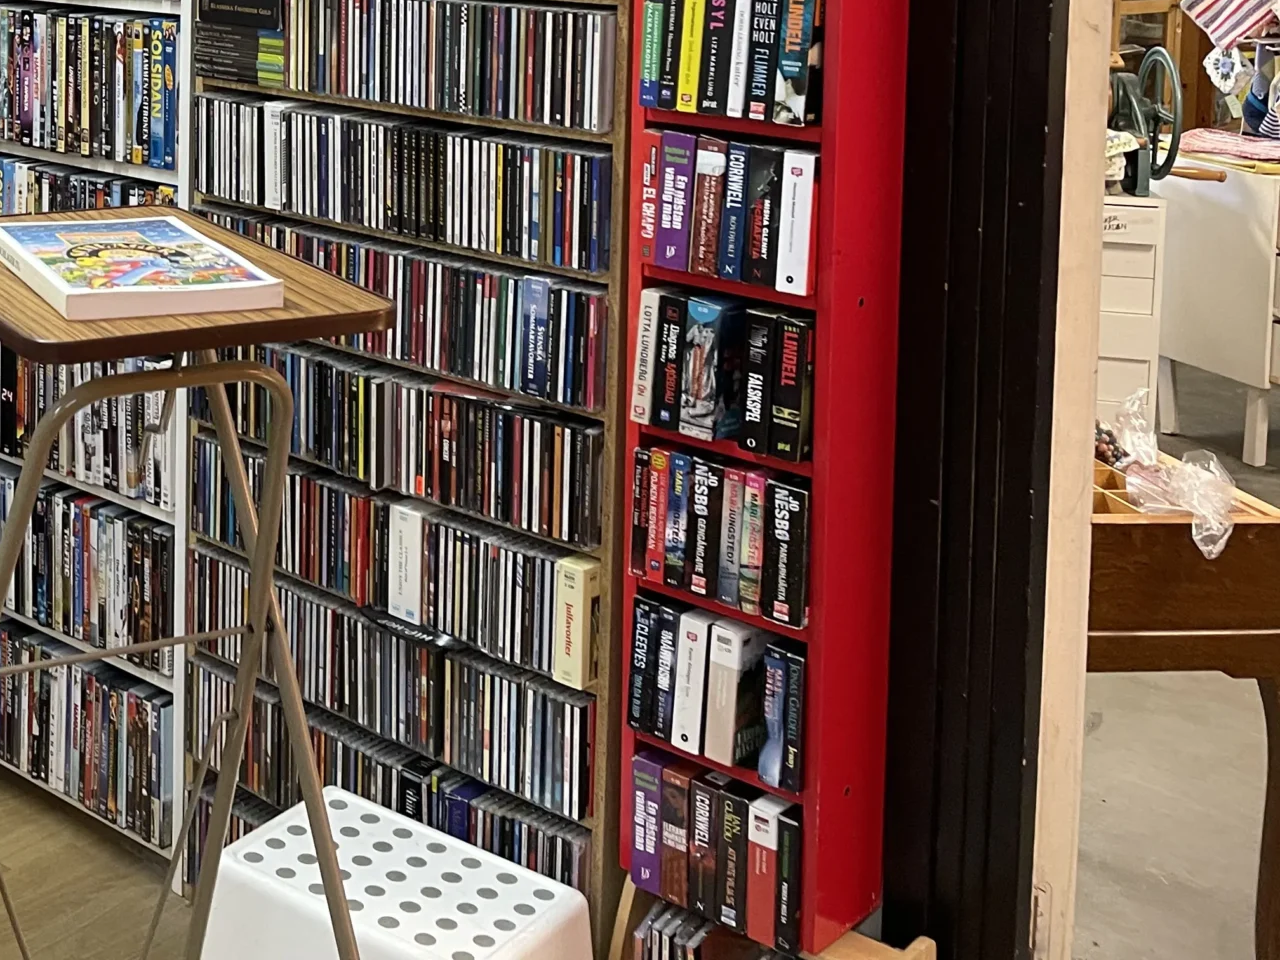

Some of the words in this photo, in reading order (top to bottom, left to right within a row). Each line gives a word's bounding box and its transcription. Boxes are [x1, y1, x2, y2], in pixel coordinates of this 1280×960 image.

[754, 2, 777, 15] HOLT
[754, 17, 776, 31] EVEN
[710, 37, 718, 54] LIZA
[753, 31, 775, 44] HOLT
[151, 30, 162, 119] SOLSIDAN
[706, 56, 717, 96] MARKLUND
[752, 48, 769, 96] FLIMMER
[644, 188, 656, 199] EL
[661, 167, 676, 204] vanlig
[675, 175, 688, 189] En
[726, 155, 747, 208] CORNWELL
[640, 202, 656, 238] CHAPO
[661, 206, 674, 229] man
[673, 190, 686, 229] nästan
[763, 200, 772, 226] MISHA
[761, 228, 770, 259] GLENNY
[642, 305, 654, 333] LOTTA
[638, 335, 651, 380] LUNDBERG
[780, 332, 800, 386] LINDELL
[1, 388, 14, 402] 24
[746, 373, 764, 421] FALSKSPEL
[694, 465, 709, 515] NESBØ
[708, 476, 718, 490] JO
[774, 488, 789, 540] NESBØ
[788, 496, 800, 511] JO
[695, 518, 707, 573] GENGÅNGARE
[634, 623, 651, 668] CLEEVES
[788, 662, 799, 695] JONAS
[786, 745, 798, 768] Jenny
[635, 791, 645, 823] vanlig
[646, 801, 658, 815] En
[695, 796, 709, 848] CORNWELL
[635, 824, 645, 851] man
[646, 816, 656, 854] nästan
